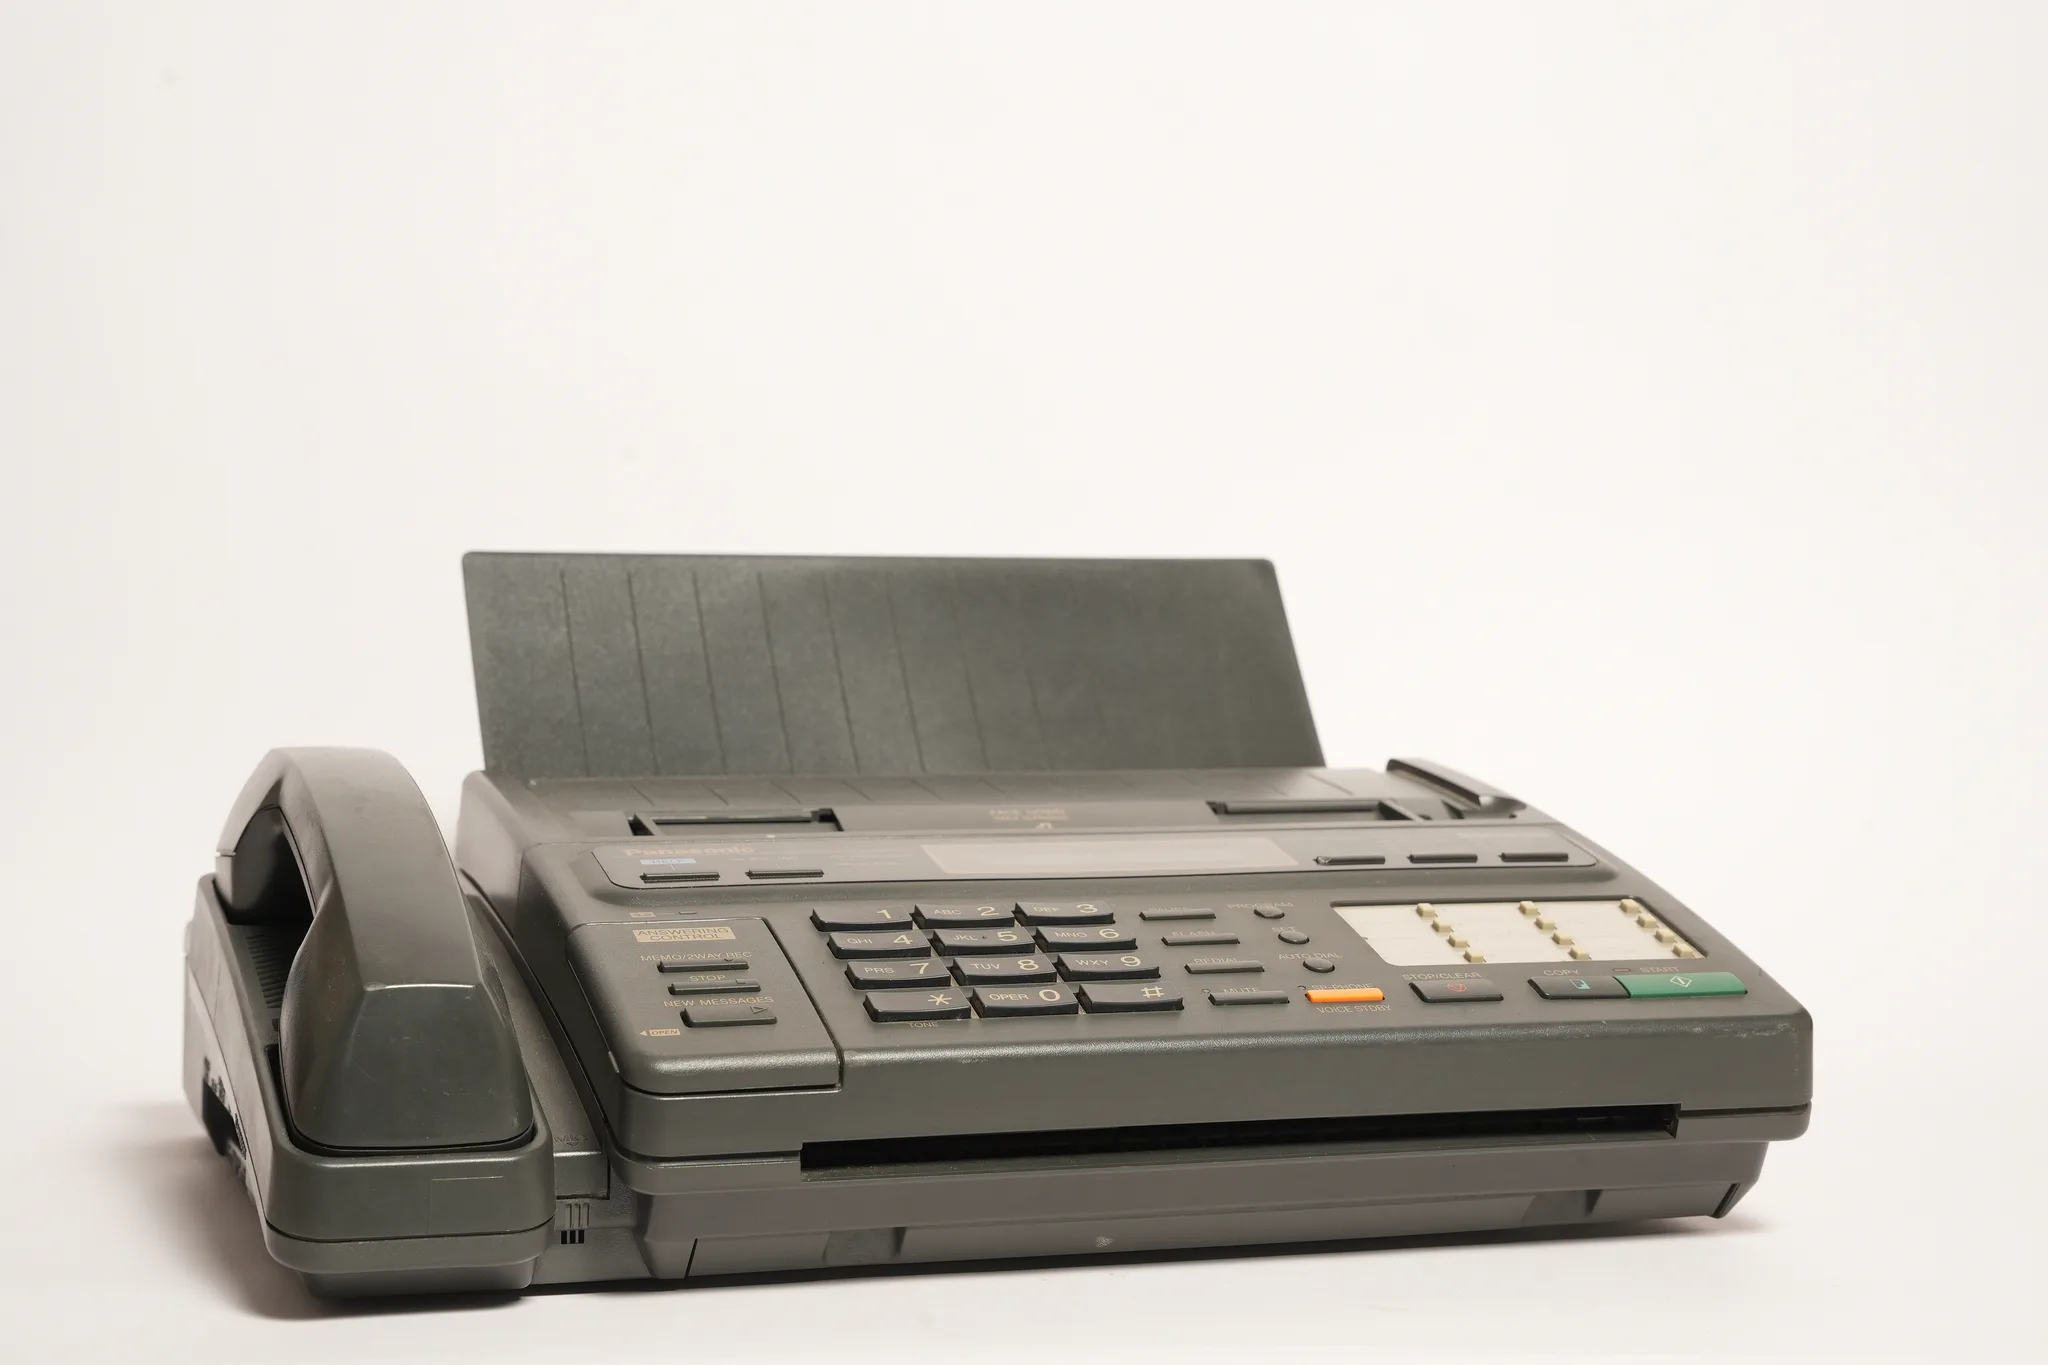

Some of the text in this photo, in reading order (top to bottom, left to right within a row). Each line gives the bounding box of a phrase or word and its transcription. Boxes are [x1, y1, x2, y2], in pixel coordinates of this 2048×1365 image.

[623, 846, 755, 856] Panasonic
[934, 905, 1000, 917] ABC 2
[1033, 903, 1099, 914] DEF 3
[877, 908, 893, 920] 1
[638, 927, 730, 936] ANSWERING
[953, 931, 1018, 942] JKL 5
[1054, 928, 1121, 940] MNO 6
[846, 934, 914, 945] GHI 4
[640, 952, 723, 962] MEMO/2WAY
[1075, 956, 1142, 968] WXY 9
[864, 962, 931, 975] PRS 7
[970, 959, 1040, 971] TUV 8
[1402, 971, 1482, 981] STOP/CLEAR
[1543, 968, 1580, 977] COPY
[689, 974, 726, 982] STOP
[1311, 982, 1373, 990] SP-PHONE
[989, 989, 1061, 1002] OPER 0
[699, 996, 775, 1006] MESSAGES
[1317, 1003, 1392, 1013] VOICE STDBY
[907, 1021, 940, 1029] TONE
